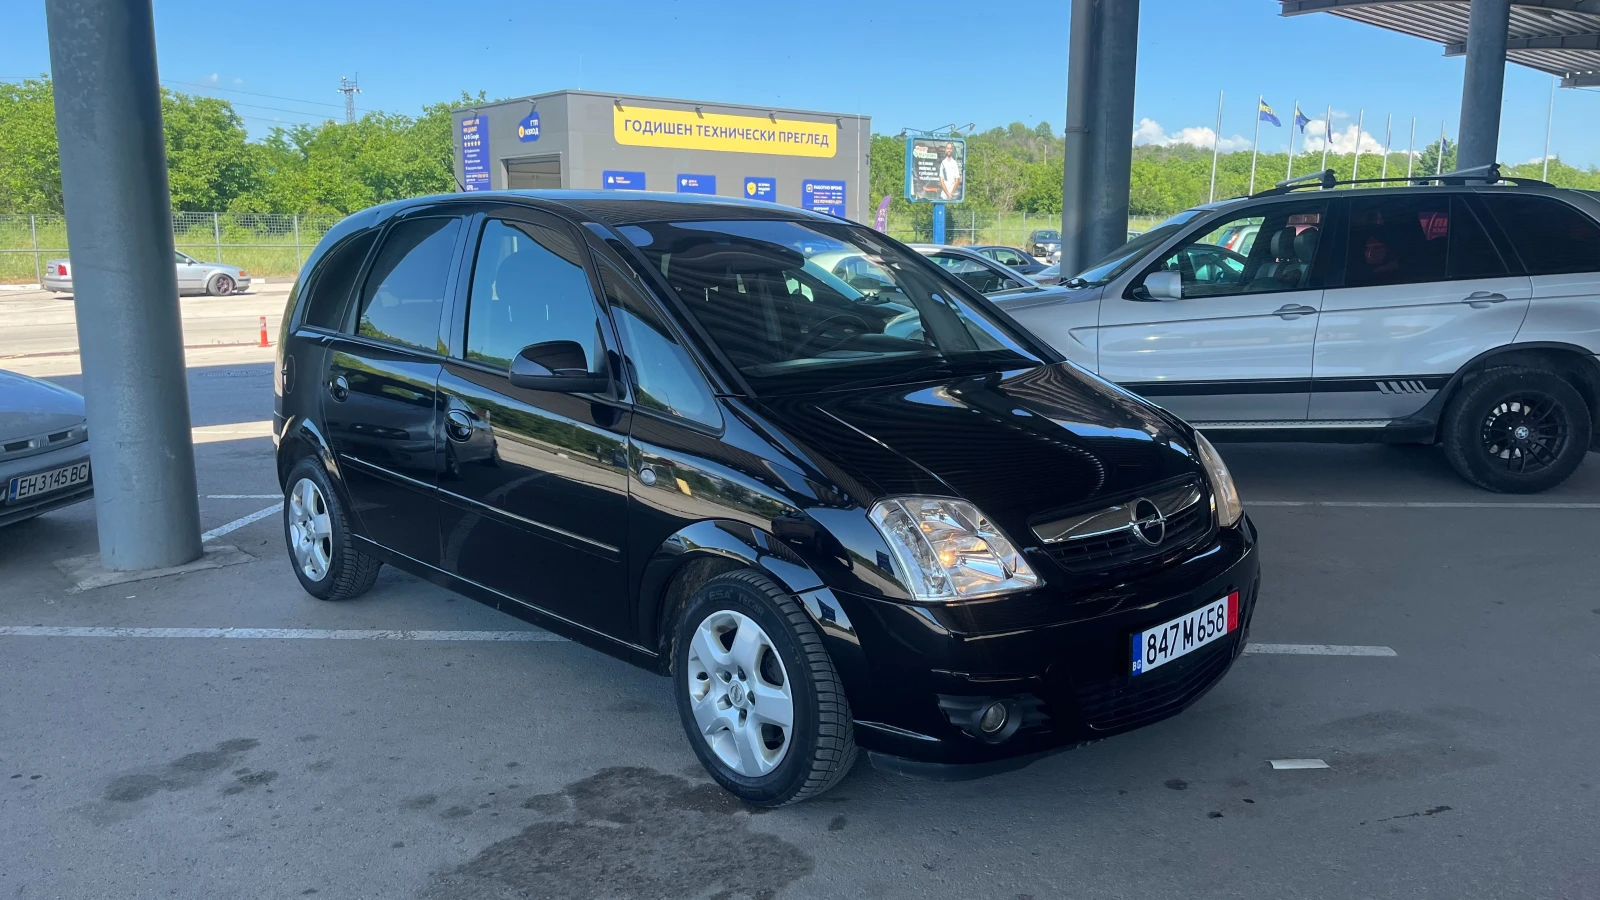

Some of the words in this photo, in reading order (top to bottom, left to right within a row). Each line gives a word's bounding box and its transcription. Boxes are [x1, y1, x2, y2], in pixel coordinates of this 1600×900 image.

[525, 127, 539, 136] ИЗХОД
[624, 119, 693, 136] ГОДИШЕН
[696, 124, 775, 142] ТЕХНИЧЕСКИ
[779, 131, 829, 148] ПРЕГЛЕД
[19, 477, 37, 496] EH
[39, 469, 68, 490] 3145
[70, 465, 87, 483] BC
[1132, 660, 1141, 671] BG
